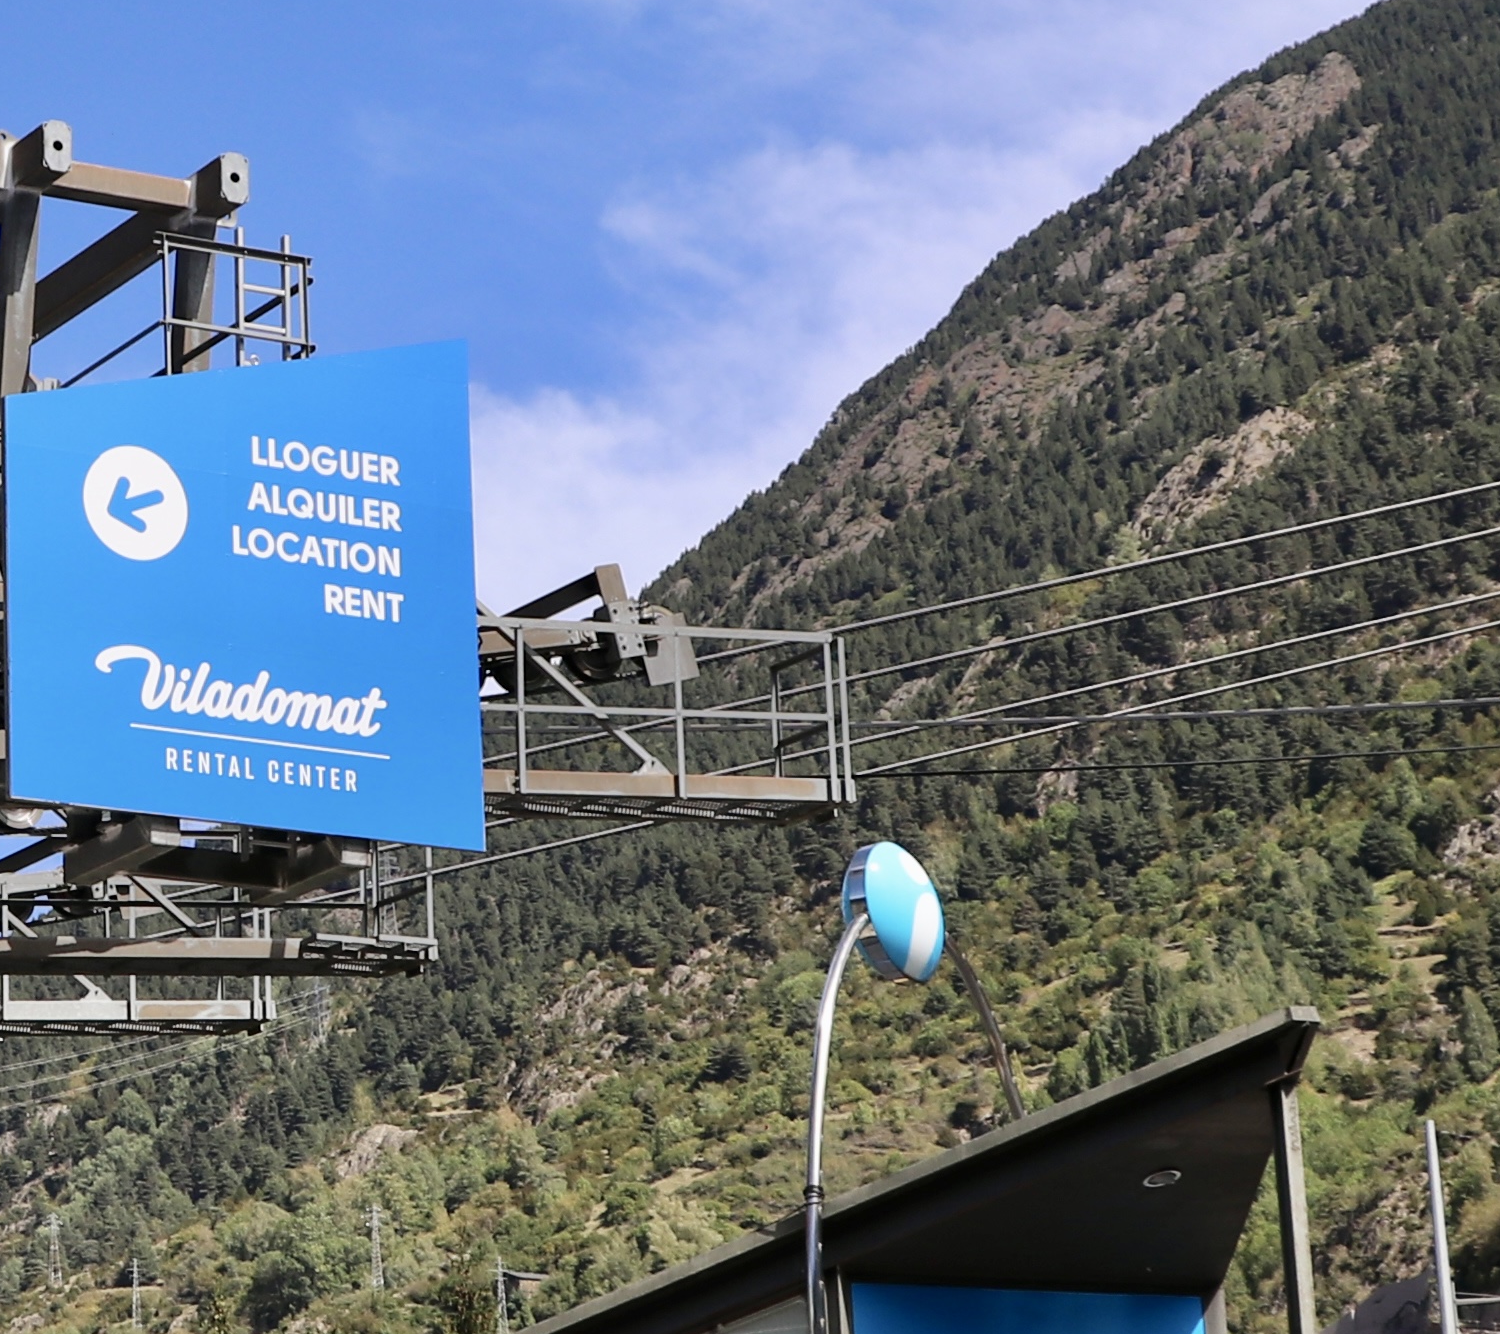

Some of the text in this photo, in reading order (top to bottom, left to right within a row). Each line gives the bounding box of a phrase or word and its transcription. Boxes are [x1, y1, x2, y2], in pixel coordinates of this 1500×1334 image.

[250, 435, 401, 486] LLOGUER
[248, 482, 402, 532] ALQUILER
[232, 525, 401, 577] LOCATION
[324, 584, 404, 623] RENT
[95, 644, 387, 737] Viladomat
[165, 747, 358, 793] RENTAL CENTER
